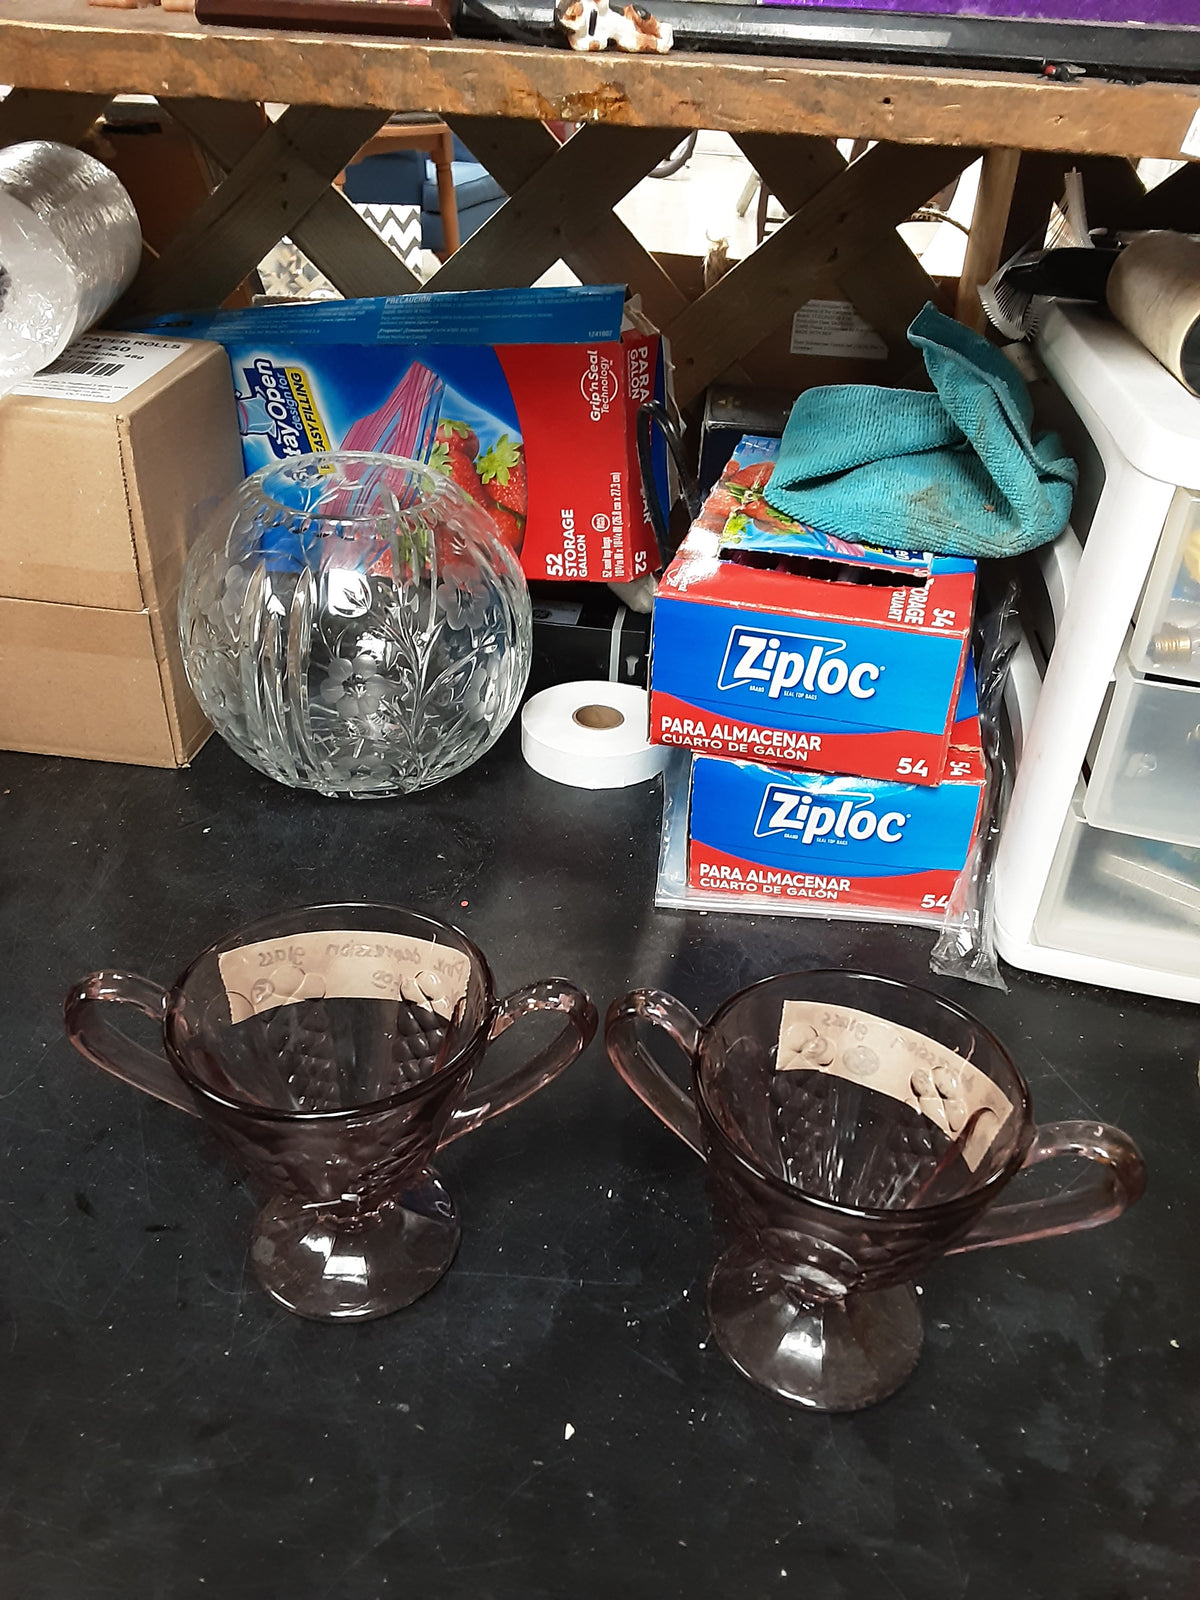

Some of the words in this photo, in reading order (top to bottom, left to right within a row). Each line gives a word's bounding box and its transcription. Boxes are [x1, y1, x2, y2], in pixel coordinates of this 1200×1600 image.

[133, 340, 182, 350] ROLLS
[276, 372, 288, 390] for
[600, 356, 610, 414] Technology
[638, 346, 650, 402] PARA
[283, 391, 303, 431] design
[291, 372, 318, 424] FILLING
[561, 509, 578, 577] STORAGE
[576, 535, 588, 578] GALLON
[545, 554, 563, 577] 52
[602, 570, 612, 578] 52
[634, 551, 647, 575] 52
[887, 590, 906, 622] QUART
[931, 608, 956, 627] 54
[733, 635, 880, 699] Ziploc
[783, 690, 795, 698] SEAL
[805, 693, 818, 701] BAGS
[661, 716, 707, 737] PARA
[711, 723, 822, 751] ALMACENAR
[661, 733, 723, 749] CUARTO
[728, 742, 748, 753] DE
[753, 745, 808, 761] GALÓN
[896, 757, 929, 778] 54
[949, 760, 971, 776] 54
[768, 792, 906, 845] Ziploc
[699, 878, 757, 892] CUARTO
[762, 885, 782, 895] DE
[786, 886, 838, 900] GALÓN
[700, 863, 743, 881] PARA
[746, 870, 851, 892] ALMACENAR
[921, 894, 949, 910] 54
